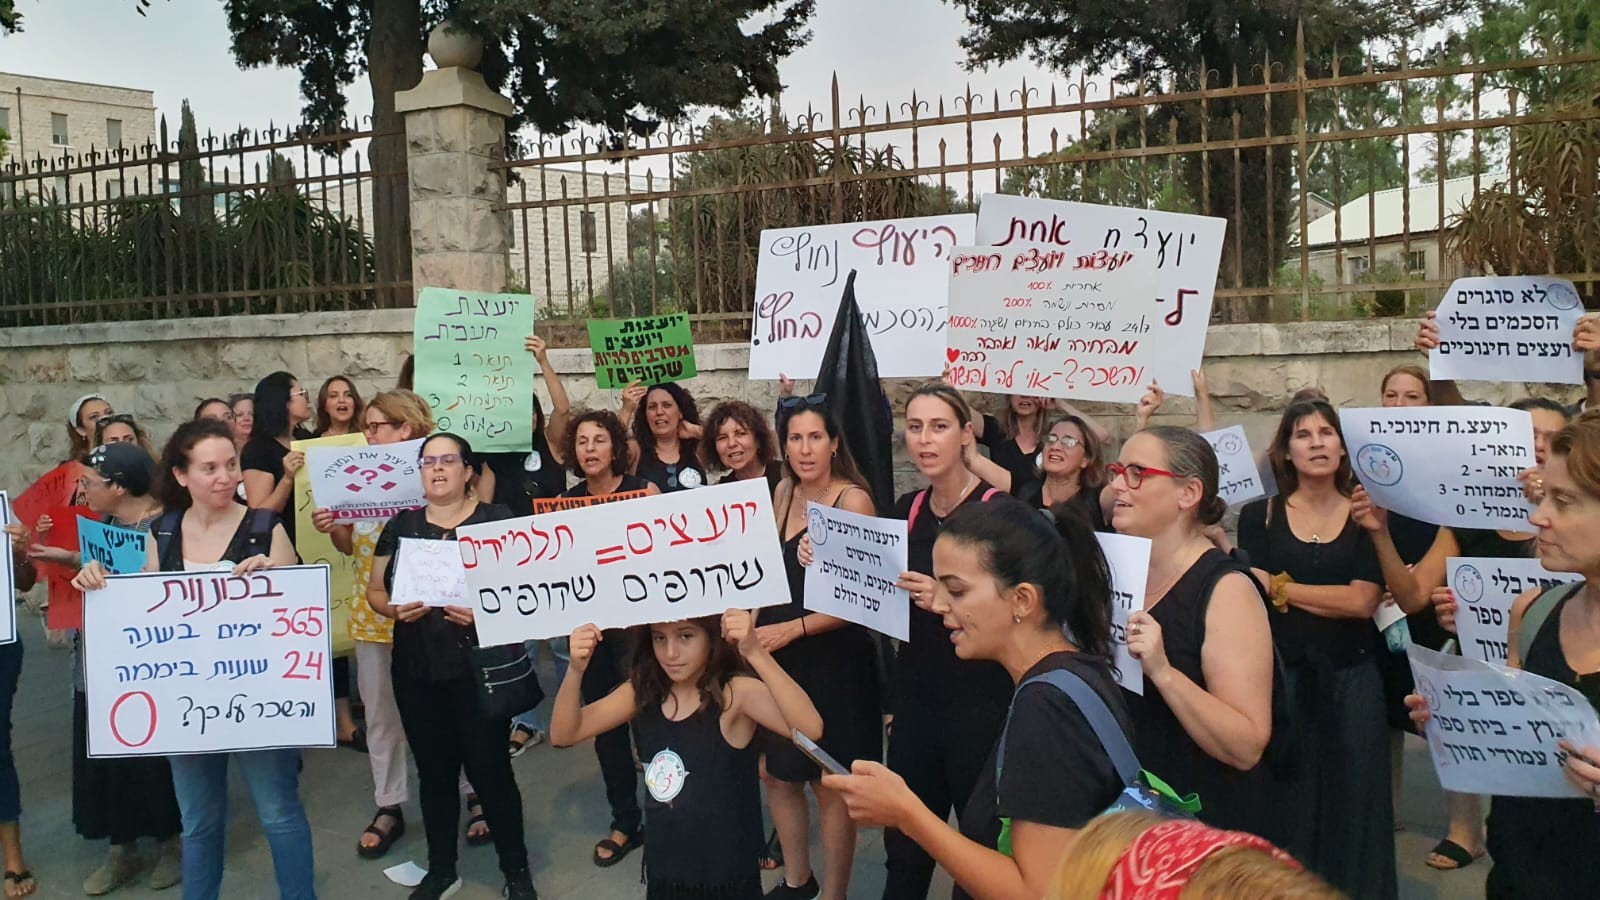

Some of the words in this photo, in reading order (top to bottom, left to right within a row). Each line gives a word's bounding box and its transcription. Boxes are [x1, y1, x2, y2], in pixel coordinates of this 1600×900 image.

[992, 213, 1071, 247] אחת
[1073, 250, 1135, 273] יועצות
[1027, 281, 1053, 291] 100%
[1521, 284, 1547, 303] לא
[444, 296, 519, 316] יועצת
[1003, 297, 1032, 308] 200%
[1457, 290, 1514, 305] סוגרים
[620, 316, 683, 333] יועצות
[948, 314, 977, 329] 1000%
[1449, 311, 1480, 330] בלי
[1485, 315, 1559, 330] הסכמים
[604, 332, 663, 351] ויועצים
[1026, 333, 1062, 352] מלאה
[1067, 338, 1139, 356] מבחירה
[1439, 341, 1509, 356] חינוכיים
[1517, 342, 1572, 357] ועצים
[453, 353, 461, 366] 1
[472, 354, 512, 372] תואר
[594, 348, 630, 367] להיות
[631, 344, 690, 365] מסרבים
[457, 374, 467, 386] 2
[482, 375, 514, 391] תואר
[429, 393, 441, 408] 3
[445, 393, 513, 410] התמחות
[464, 414, 512, 438] תגמול
[359, 452, 378, 460] את
[1461, 465, 1470, 476] 2
[1439, 484, 1447, 495] 3
[1456, 504, 1465, 515] 0
[1482, 502, 1529, 519] תגמול
[827, 518, 861, 537] ויועצים
[103, 528, 145, 552] הייעוץ
[458, 520, 574, 569] תלמידים
[863, 528, 900, 547] יועצות
[846, 546, 882, 567] דורשים
[1492, 568, 1522, 594] בלי
[146, 575, 284, 617] בכוננות
[834, 584, 858, 605] הולם
[860, 597, 880, 612] שכר
[271, 606, 325, 637] 365
[1469, 605, 1503, 626] ספר
[123, 623, 201, 649] בשנה
[217, 623, 262, 640] ימים
[114, 660, 200, 683] ביממה
[205, 659, 269, 681] שעות
[282, 650, 324, 681] 24
[1443, 684, 1479, 706] בלי
[1481, 689, 1526, 707] ספר
[225, 693, 249, 724] על
[250, 700, 315, 719] והשכר
[1433, 713, 1465, 732] ספר
[1468, 718, 1508, 735] בית
[1443, 742, 1486, 765] תווך
[1487, 747, 1548, 766] עמודי
